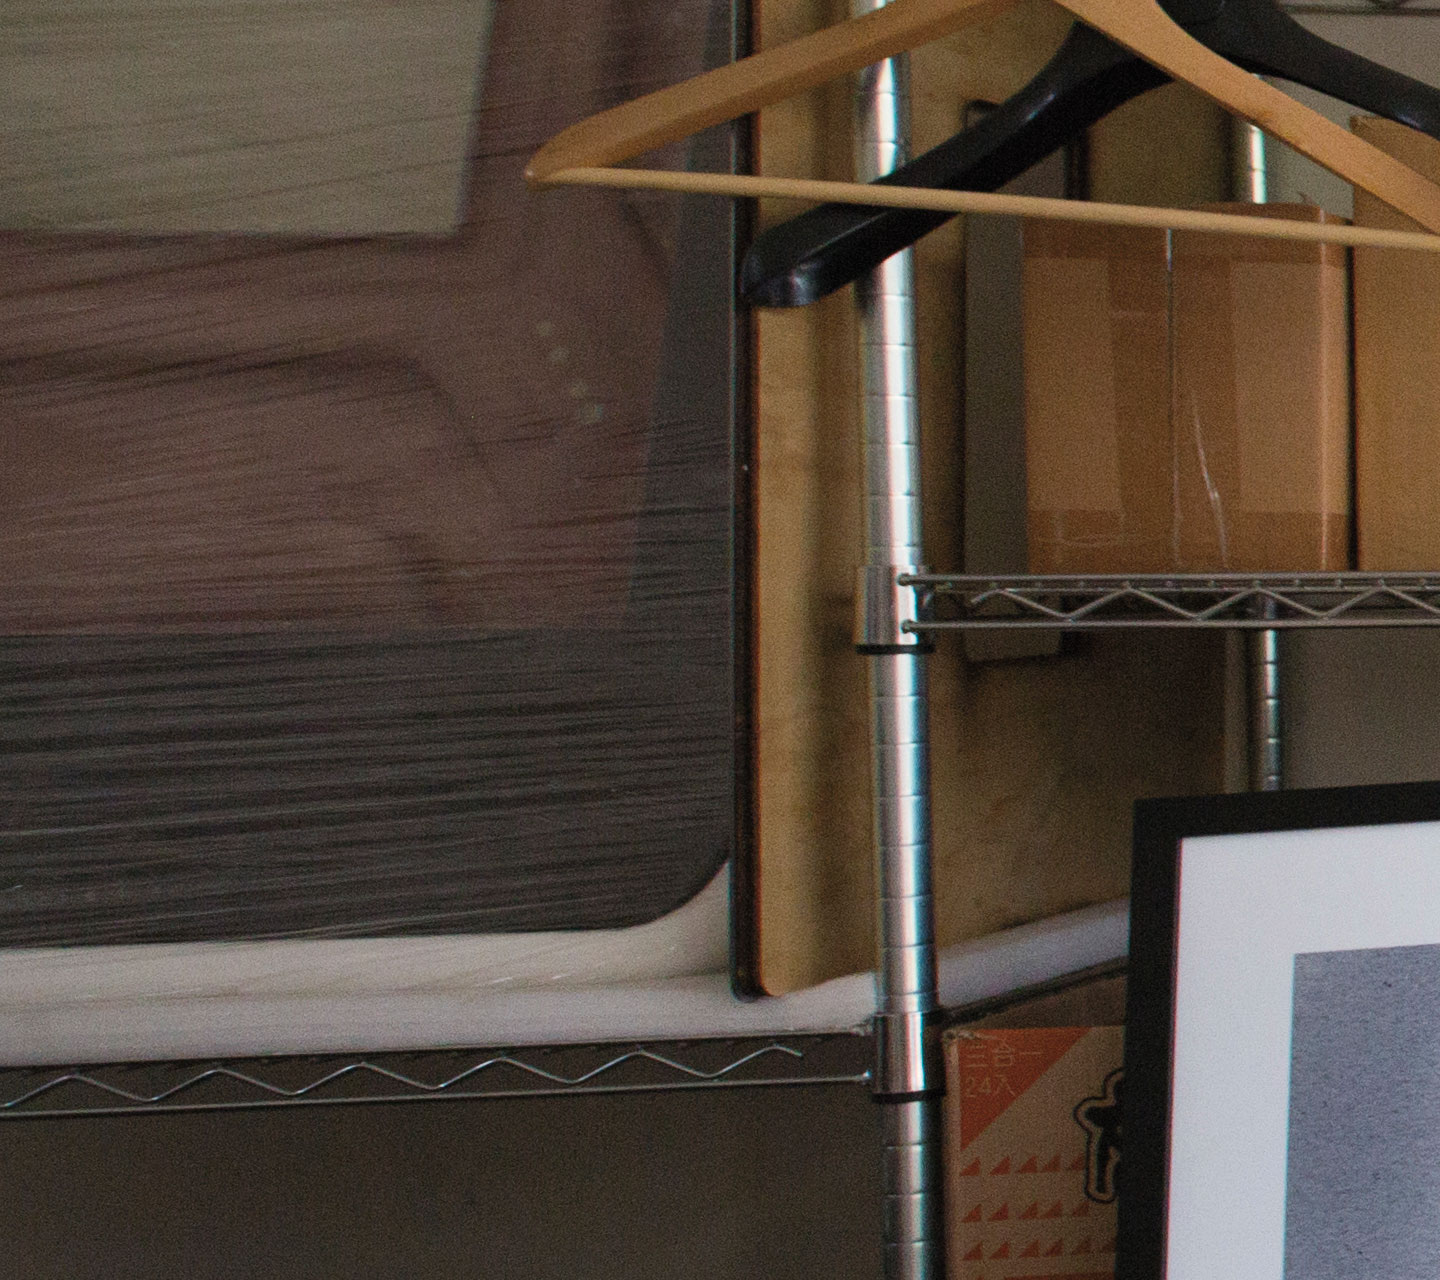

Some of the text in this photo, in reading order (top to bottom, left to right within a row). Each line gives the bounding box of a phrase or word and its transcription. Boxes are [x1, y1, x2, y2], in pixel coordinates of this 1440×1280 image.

[964, 1038, 1042, 1068] 三合一
[964, 1075, 1016, 1099] 24入
